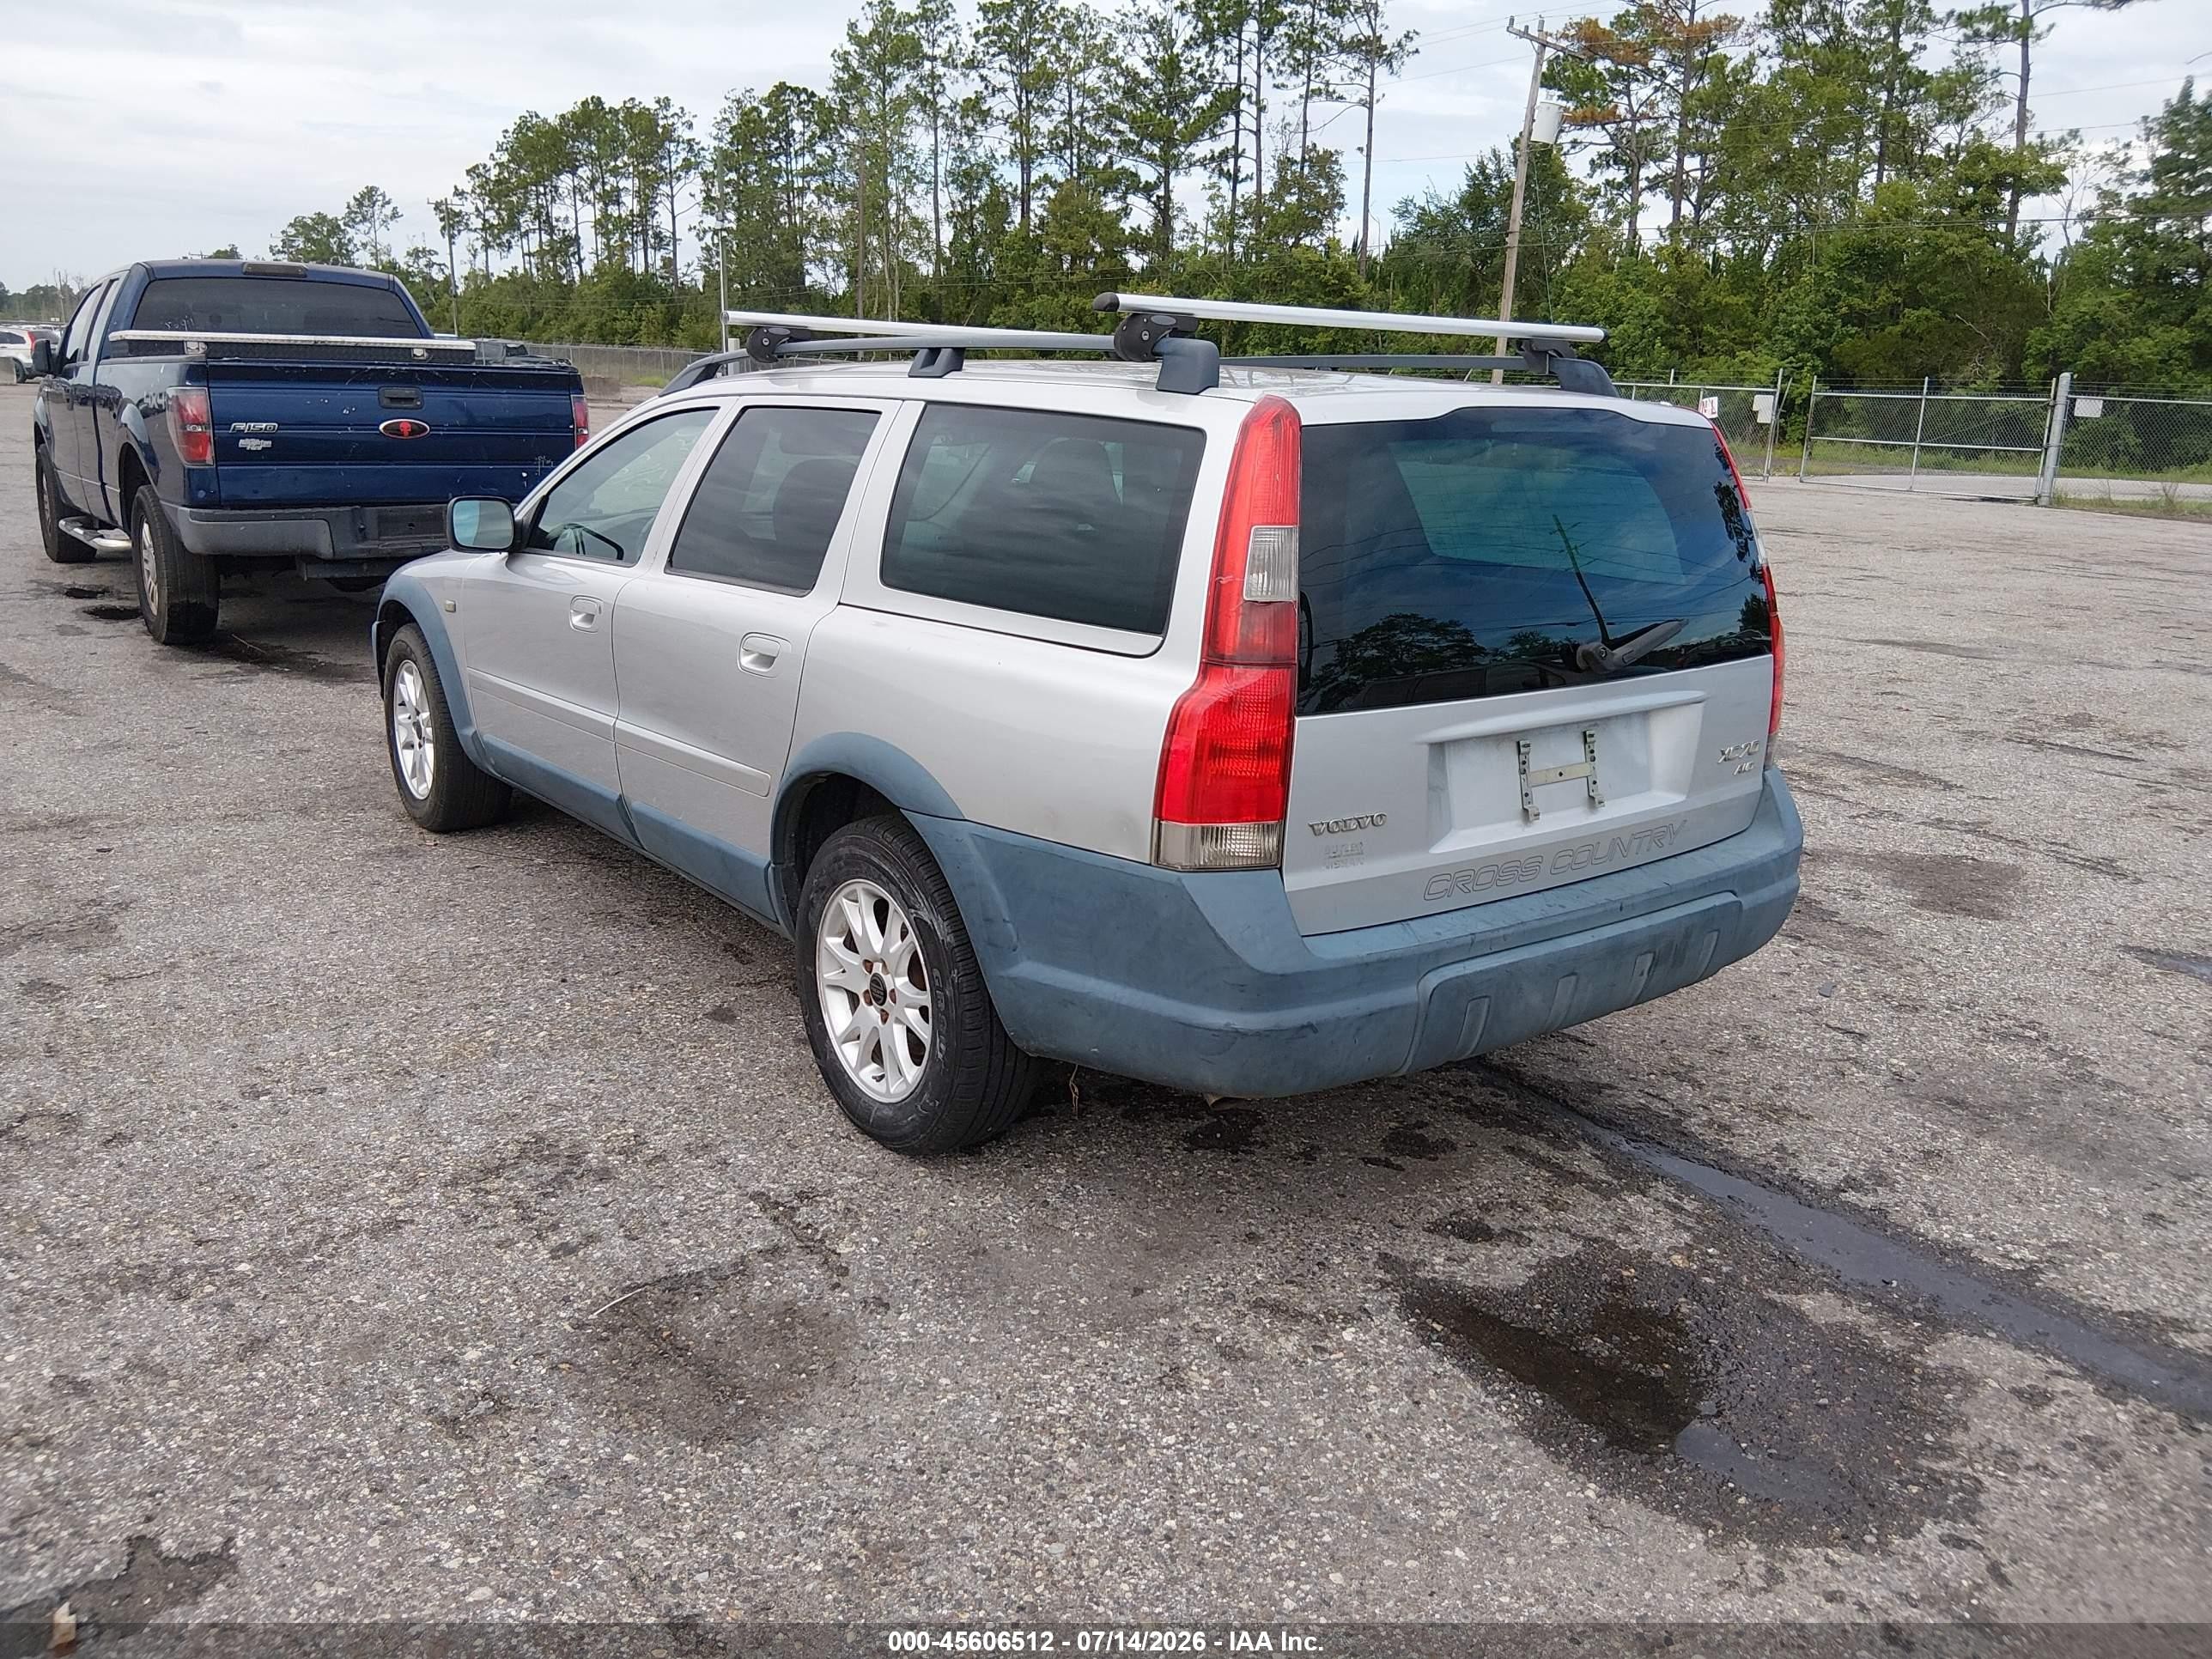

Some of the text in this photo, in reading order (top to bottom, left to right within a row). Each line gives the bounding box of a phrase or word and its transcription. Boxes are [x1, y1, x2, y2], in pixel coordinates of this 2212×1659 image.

[1308, 812, 1388, 836] VOLVO
[1423, 820, 1687, 901] CROSS COUNTRY
